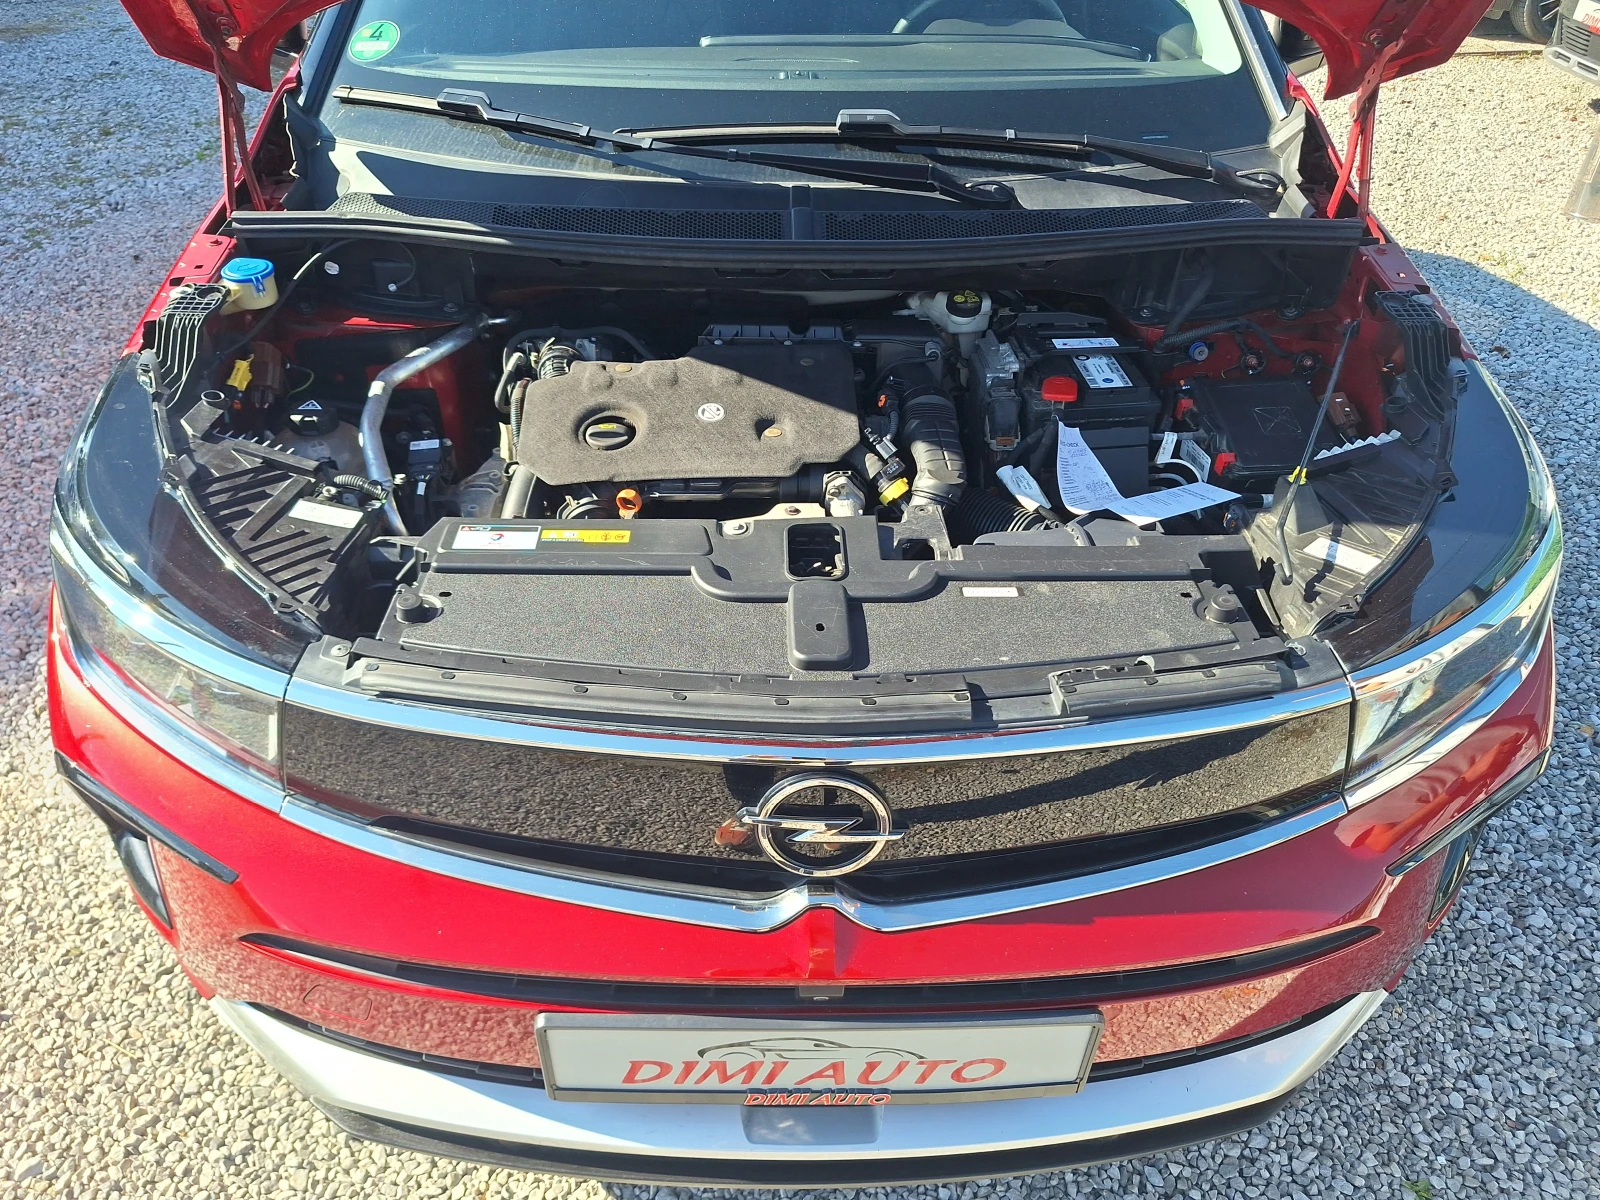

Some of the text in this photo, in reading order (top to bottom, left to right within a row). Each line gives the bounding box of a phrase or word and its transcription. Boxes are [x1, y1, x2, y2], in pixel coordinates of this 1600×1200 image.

[369, 23, 385, 40] 4
[621, 1057, 1007, 1086] DIMI AUTO
[743, 1092, 892, 1107] DIMI AUTO
